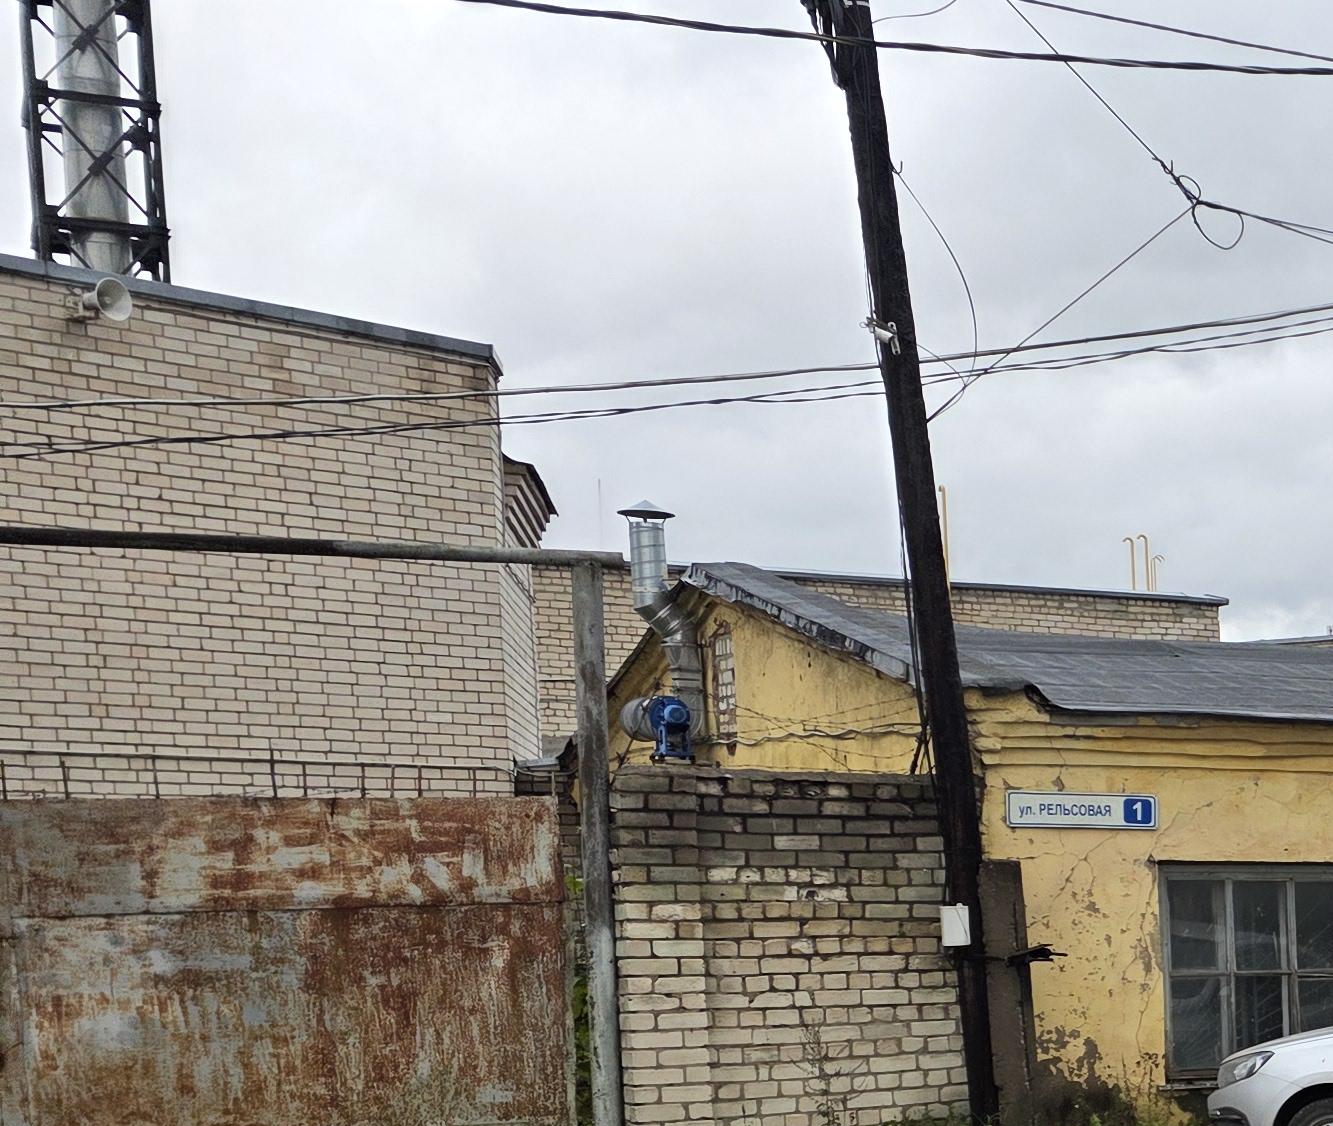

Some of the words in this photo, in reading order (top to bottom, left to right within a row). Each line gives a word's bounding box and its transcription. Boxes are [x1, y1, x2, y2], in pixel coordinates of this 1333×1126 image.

[1018, 803, 1036, 818] ул.
[1039, 802, 1112, 817] РЕЛЬСОВАЯ
[1131, 801, 1143, 821] 1
